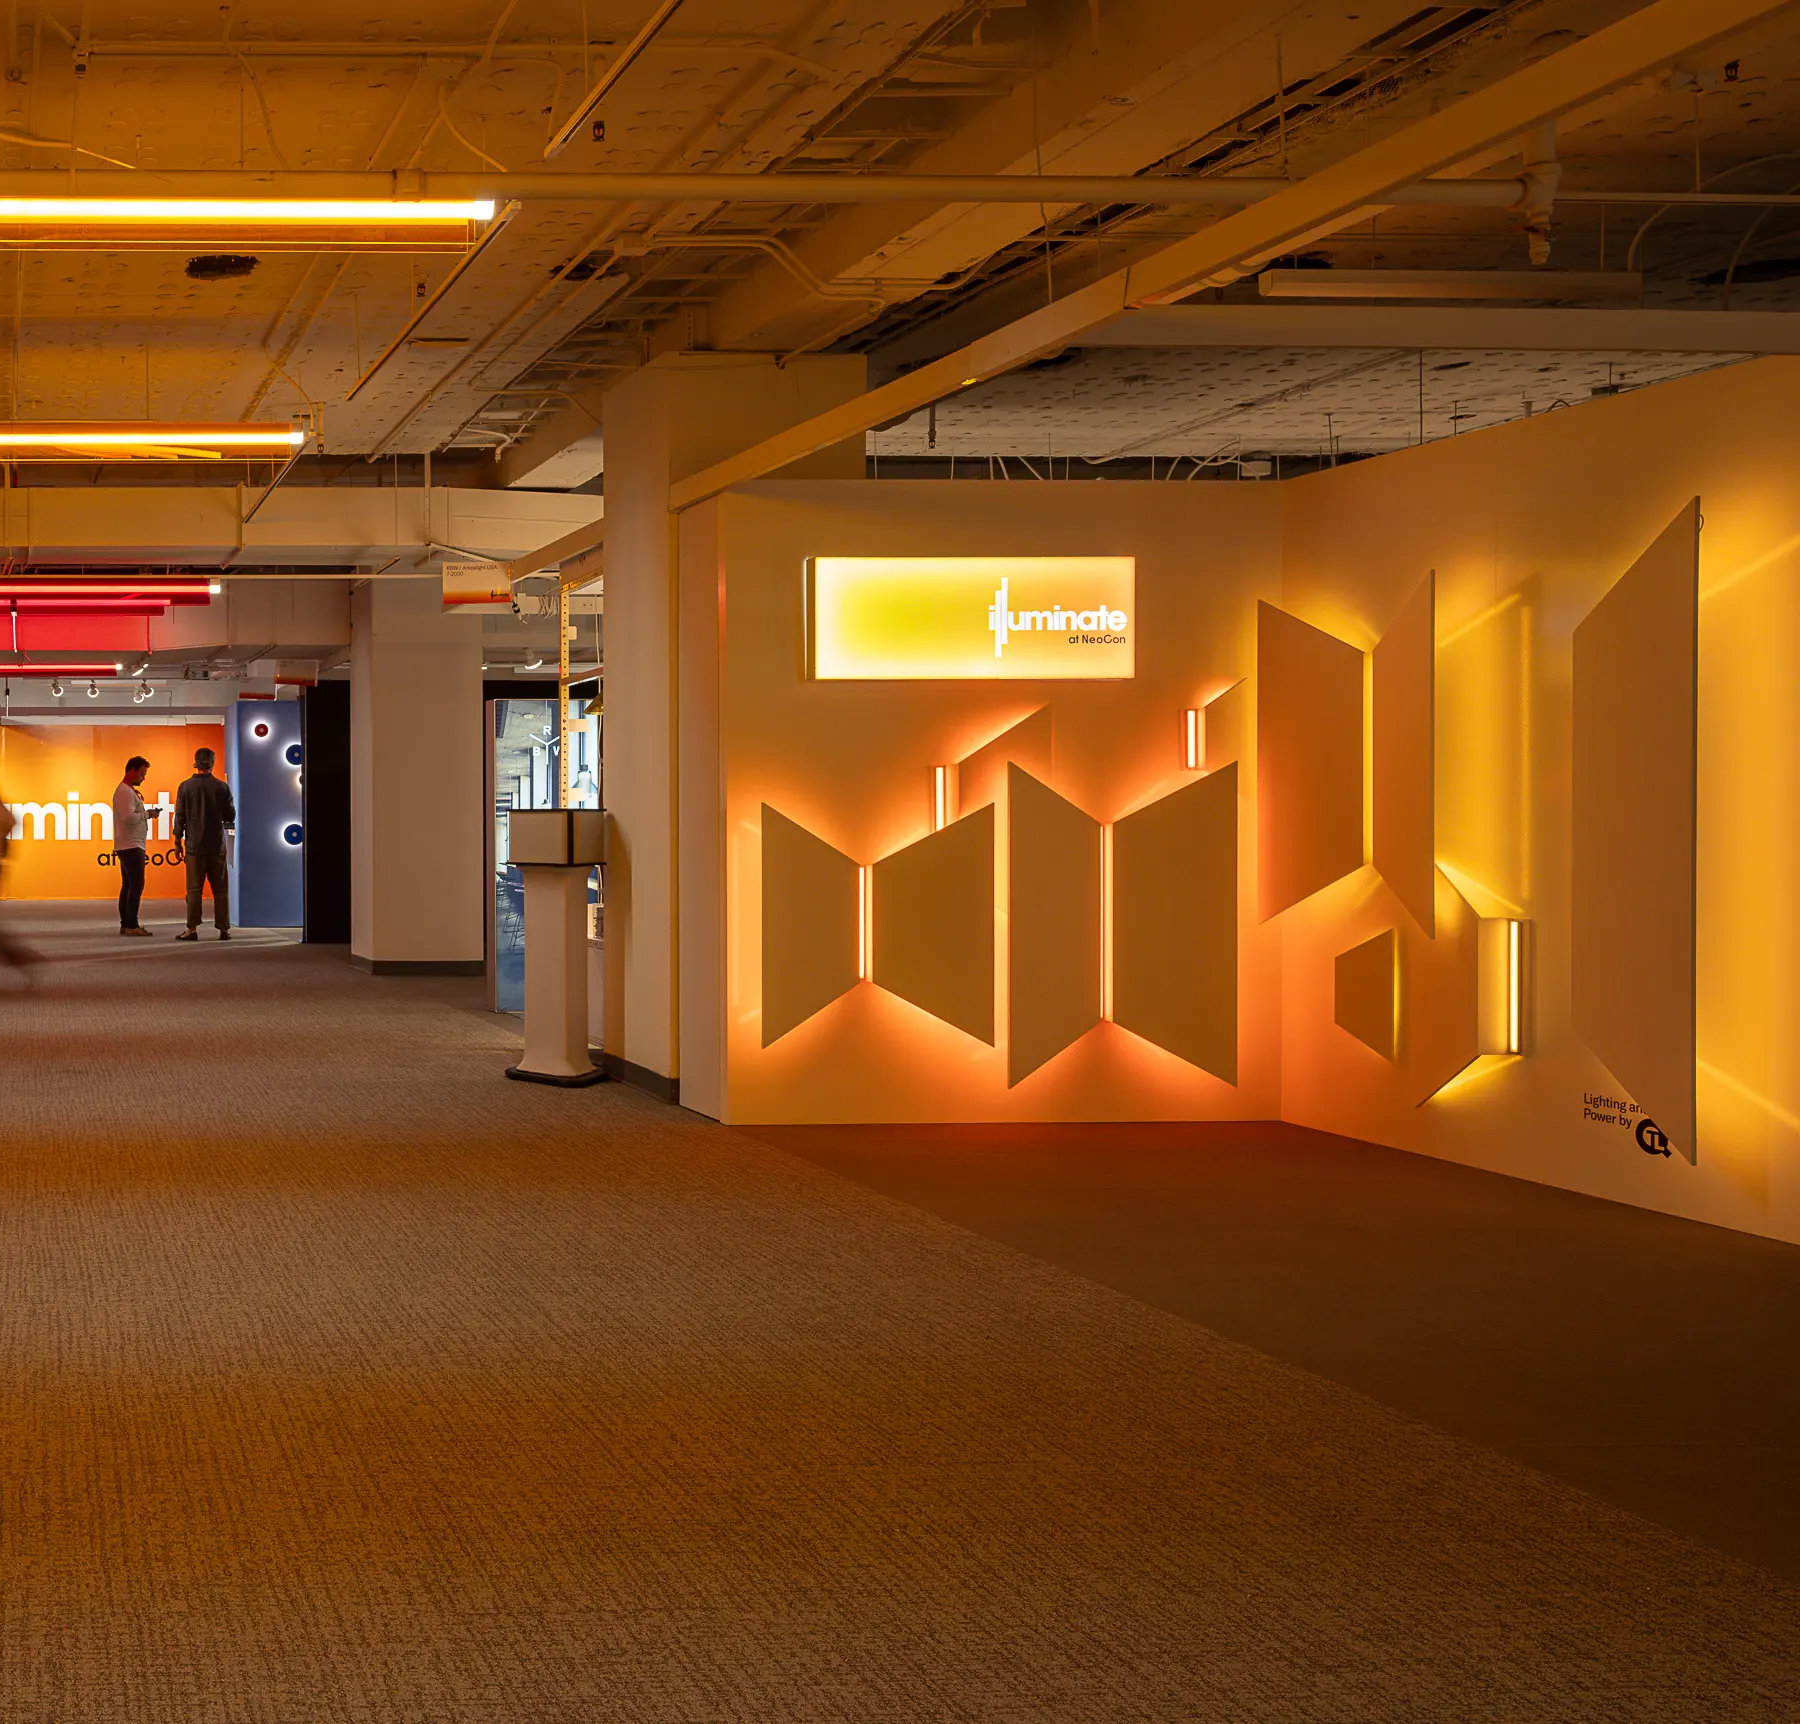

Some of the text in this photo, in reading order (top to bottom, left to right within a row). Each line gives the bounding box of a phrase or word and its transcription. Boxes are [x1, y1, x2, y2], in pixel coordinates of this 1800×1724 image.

[988, 577, 1128, 658] illuminate
[1068, 634, 1126, 644] at NeoCon
[1583, 1092, 1627, 1113] Lighting
[1583, 1107, 1632, 1129] Power by
